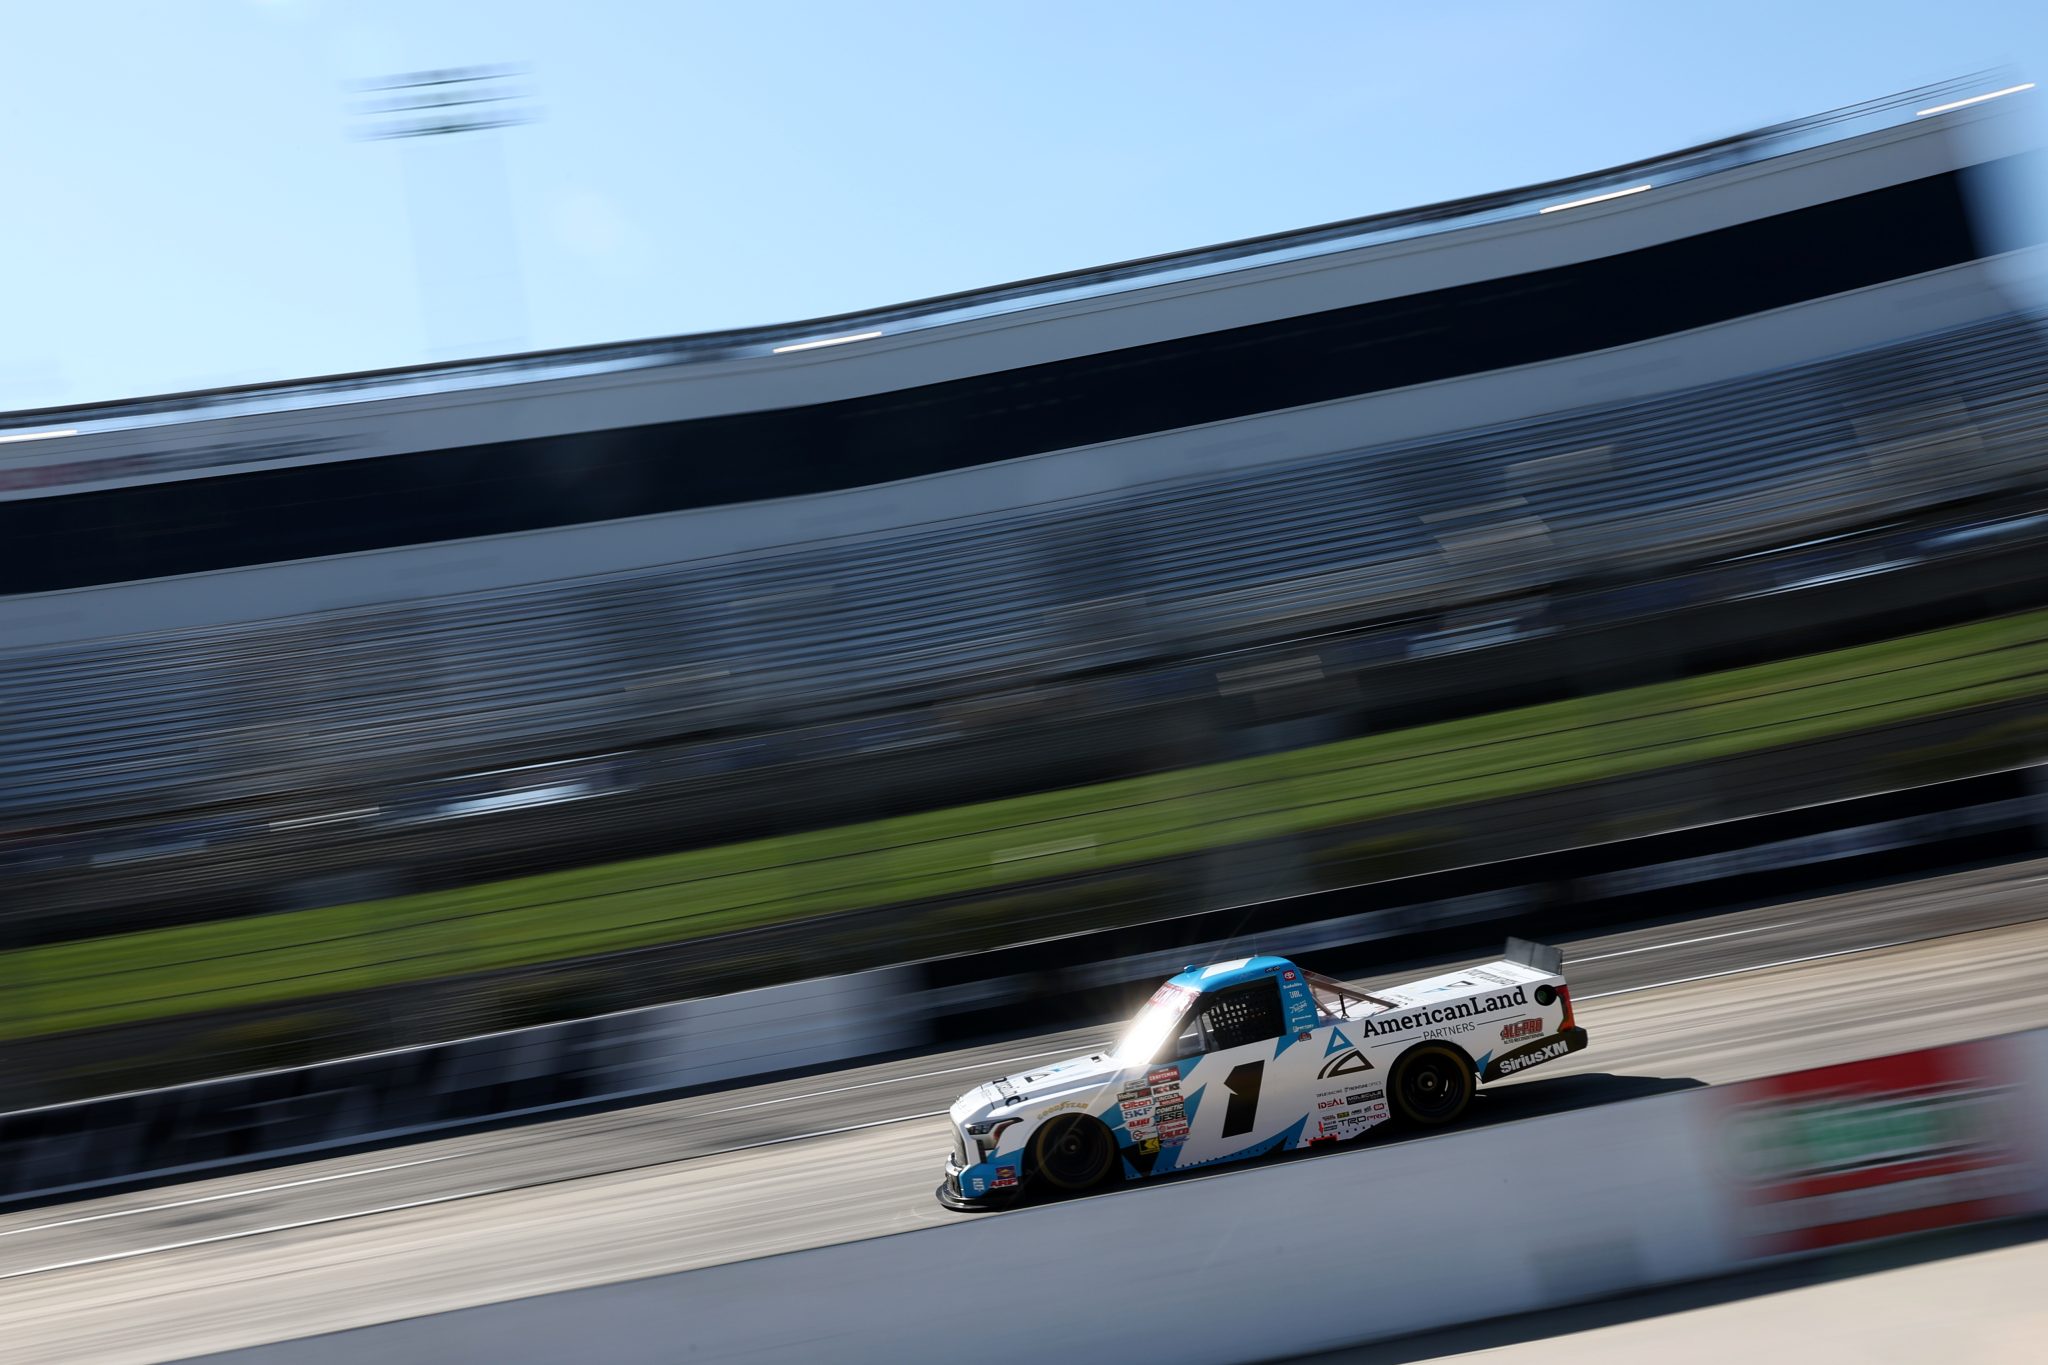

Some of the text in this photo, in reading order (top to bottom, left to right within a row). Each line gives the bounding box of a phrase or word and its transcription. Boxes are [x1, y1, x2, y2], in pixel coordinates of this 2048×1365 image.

[1363, 986, 1528, 1038] AmericanLand
[1423, 1021, 1476, 1040] PARTNERS
[1500, 1040, 1569, 1074] SiriusXM
[1222, 1060, 1265, 1138] 1
[1318, 1098, 1344, 1109] IDEAL
[1037, 1101, 1089, 1120] GOODYEAR
[1124, 1107, 1153, 1119] SKF
[990, 1178, 1018, 1189] ARP
